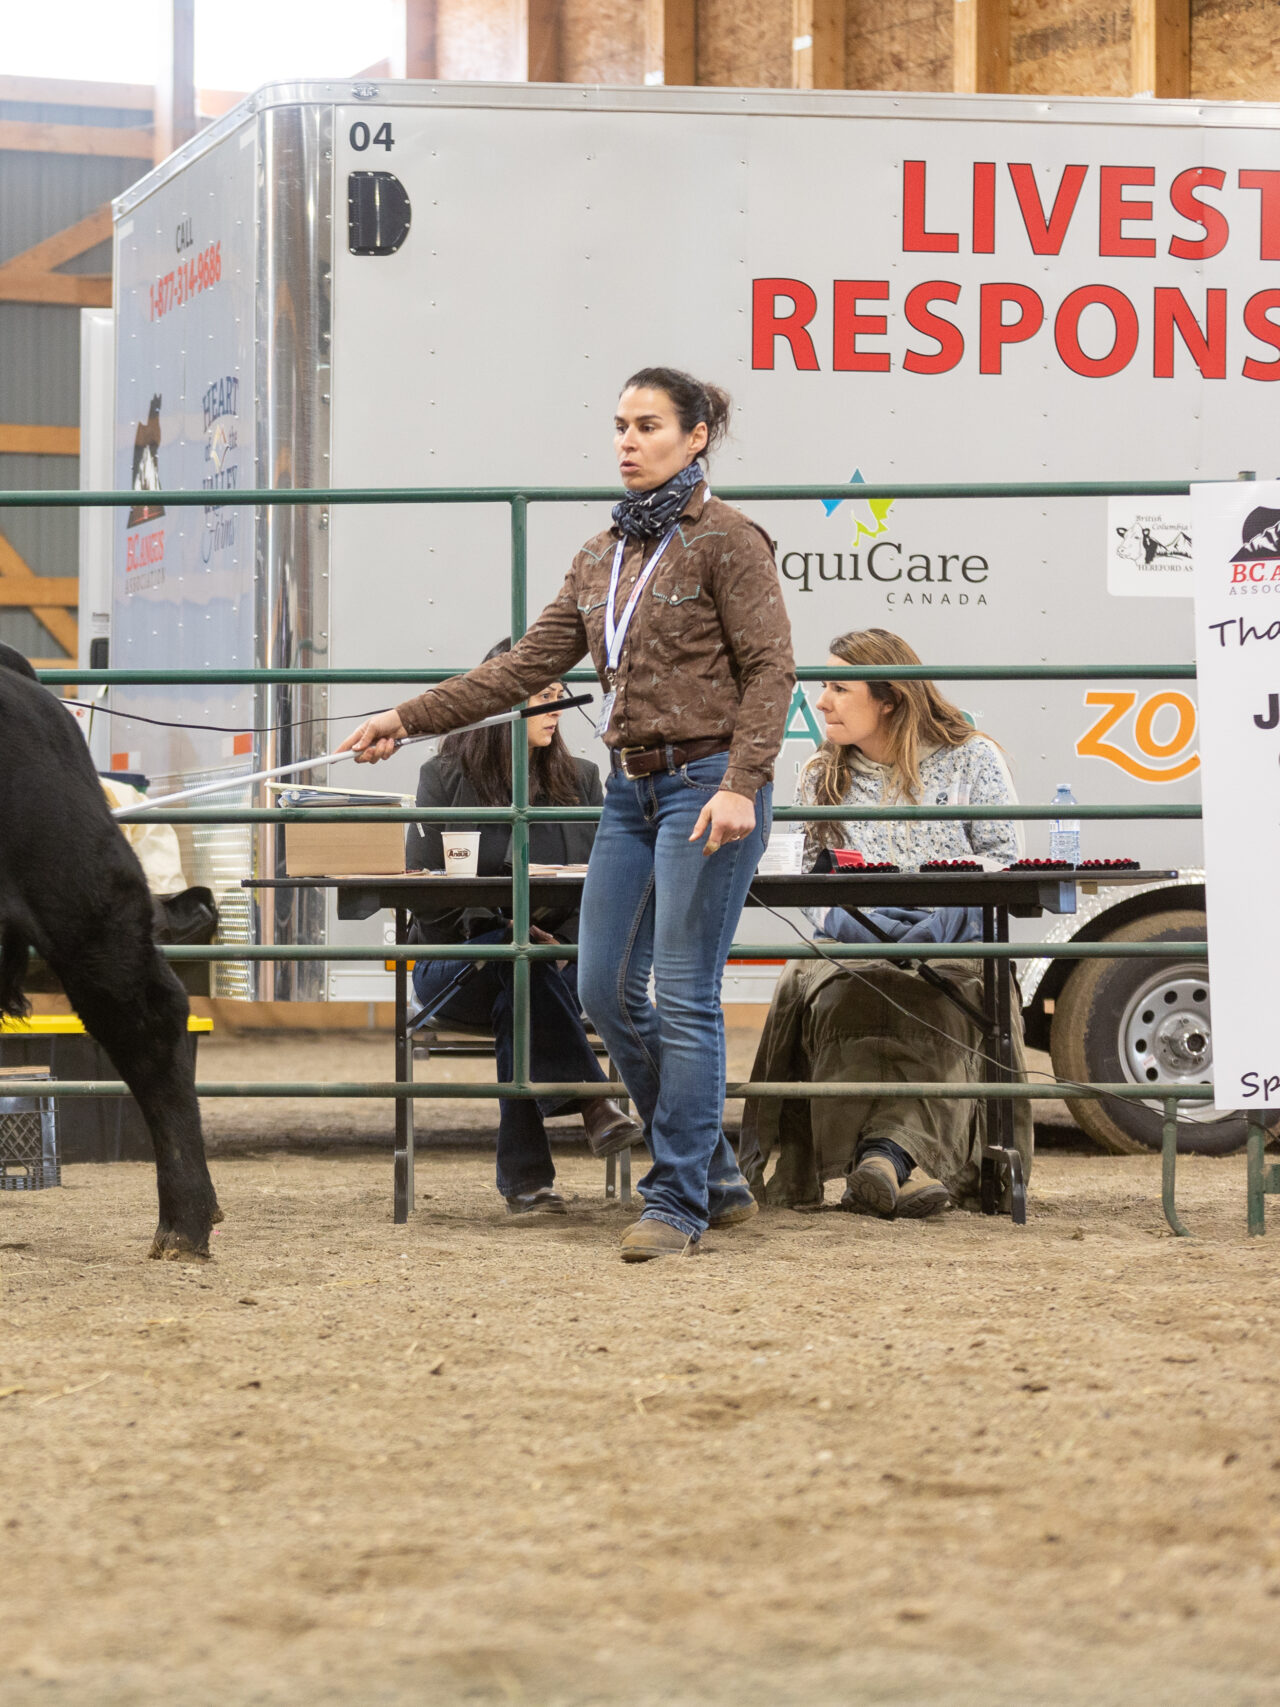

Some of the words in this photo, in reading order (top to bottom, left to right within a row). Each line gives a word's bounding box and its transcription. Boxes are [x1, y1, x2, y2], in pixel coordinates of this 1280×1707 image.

[349, 121, 395, 152] 04
[901, 160, 1280, 261] LIVEST
[176, 217, 193, 254] CALL
[751, 277, 1280, 382] RESPONS
[203, 376, 238, 434] HEART
[773, 541, 989, 592] quiCare
[1138, 564, 1182, 572] HEREFORD
[886, 592, 987, 605] CANADA
